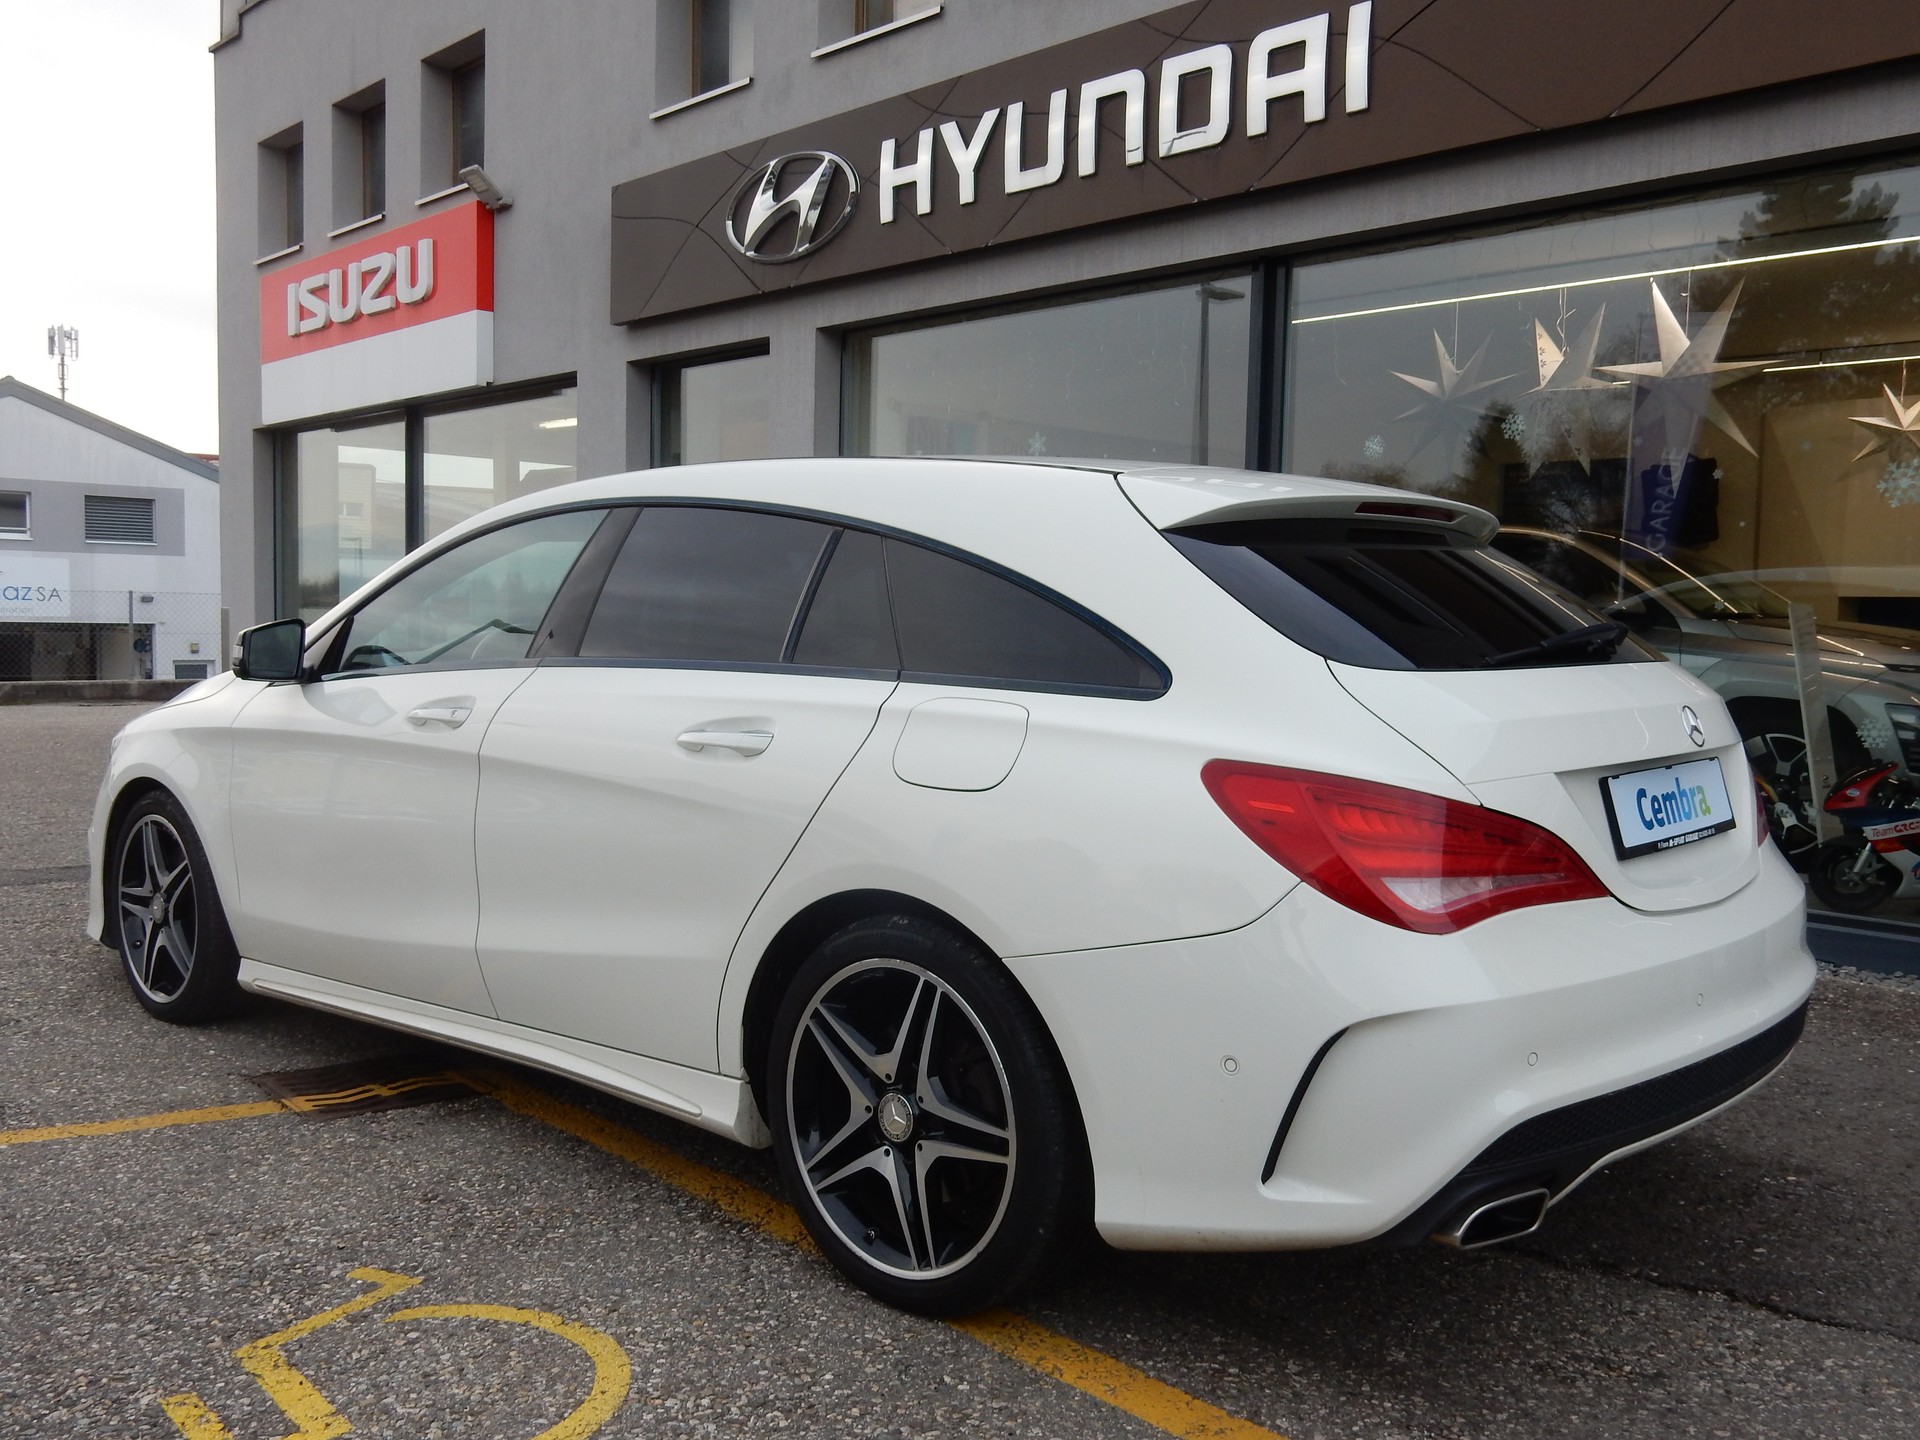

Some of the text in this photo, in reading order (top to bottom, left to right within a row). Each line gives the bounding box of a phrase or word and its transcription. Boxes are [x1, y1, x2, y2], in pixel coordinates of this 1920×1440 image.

[879, 0, 1372, 225] HYUNDAI
[287, 238, 434, 338] ISUZU
[1646, 447, 1686, 551] GARAGE
[1636, 777, 1712, 831] Cembra
